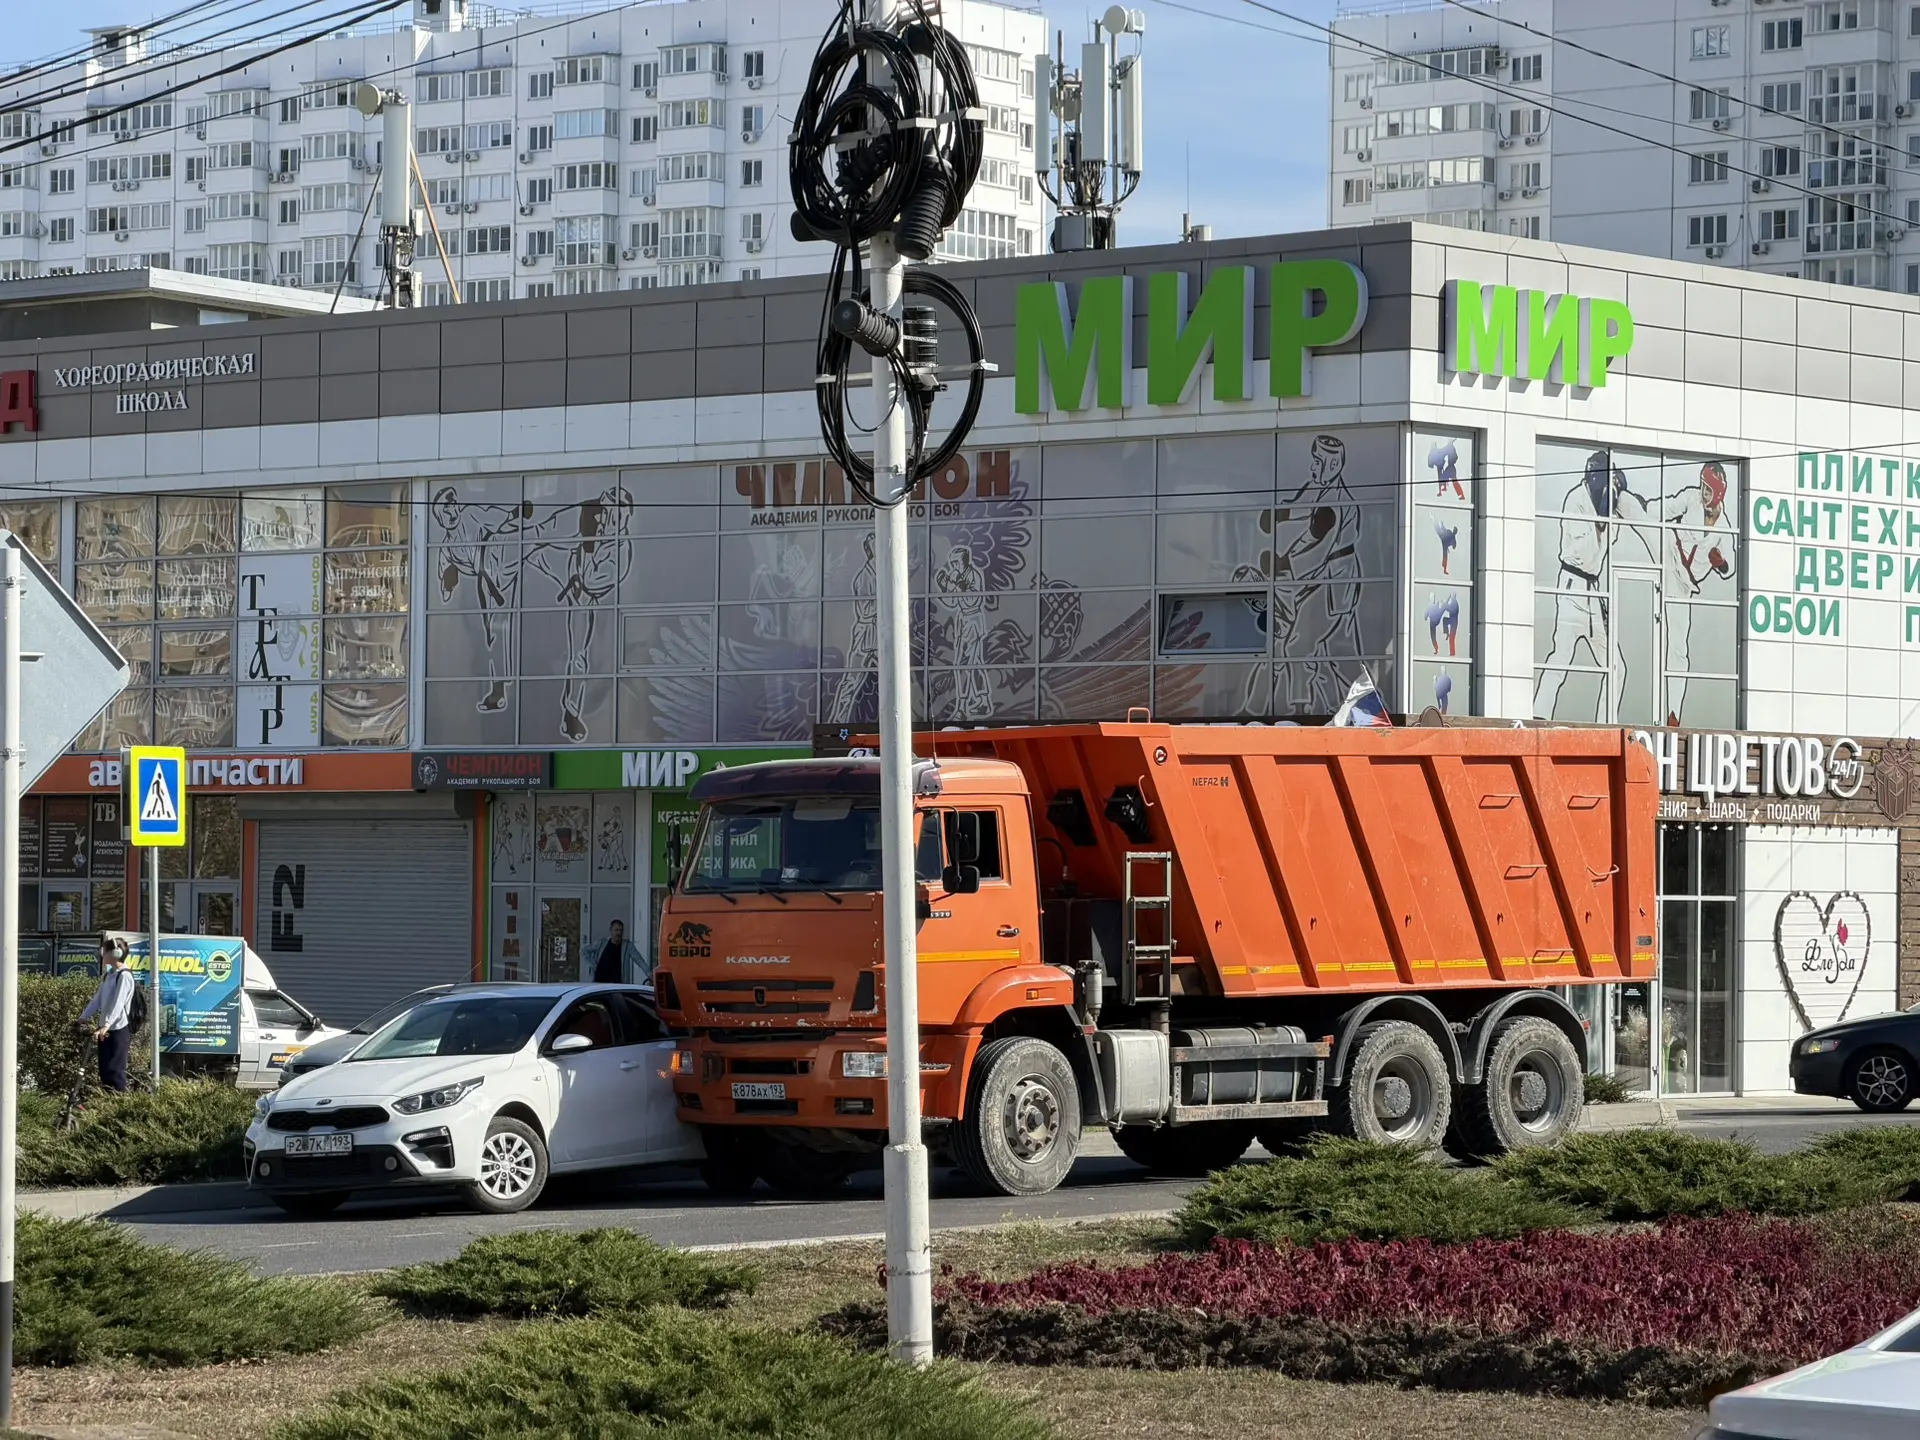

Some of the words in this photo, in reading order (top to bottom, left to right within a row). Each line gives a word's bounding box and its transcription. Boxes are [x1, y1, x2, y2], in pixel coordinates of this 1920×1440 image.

[1015, 259, 1368, 414] МИР
[1450, 279, 1634, 388] МИР
[54, 353, 255, 388] ХОРЕОГРАФИЧЕСКАЯ
[116, 390, 188, 414] ШКОЛА
[751, 510, 818, 527] АКАДЕМИЯ
[826, 504, 925, 522] РУКОПАГО
[934, 503, 960, 517] БОЯ
[312, 555, 321, 613] 8918
[1750, 594, 1840, 637] ОБОИ
[241, 574, 291, 745] ТЕАТР
[310, 621, 320, 679] 6402
[309, 691, 319, 734] 453
[446, 755, 543, 777] ЧЕМПИОН
[621, 751, 700, 788] МИР
[1688, 732, 1826, 804] ЦВЕТОВ
[1833, 758, 1858, 779] 24/7
[446, 778, 479, 786] АКАДЕМИЯ
[481, 778, 525, 786] РУКОПАШНОГО
[528, 778, 541, 786] БОЯ
[1192, 777, 1219, 787] NEFAZ
[1708, 801, 1746, 819] ШАРЫ
[1767, 803, 1821, 822] ПОДАРКИ
[669, 945, 711, 957] БАРС
[725, 955, 791, 964] KAMAZ
[208, 962, 231, 970] ESTER
[769, 1084, 784, 1096] 193
[331, 1135, 350, 1148] 193
